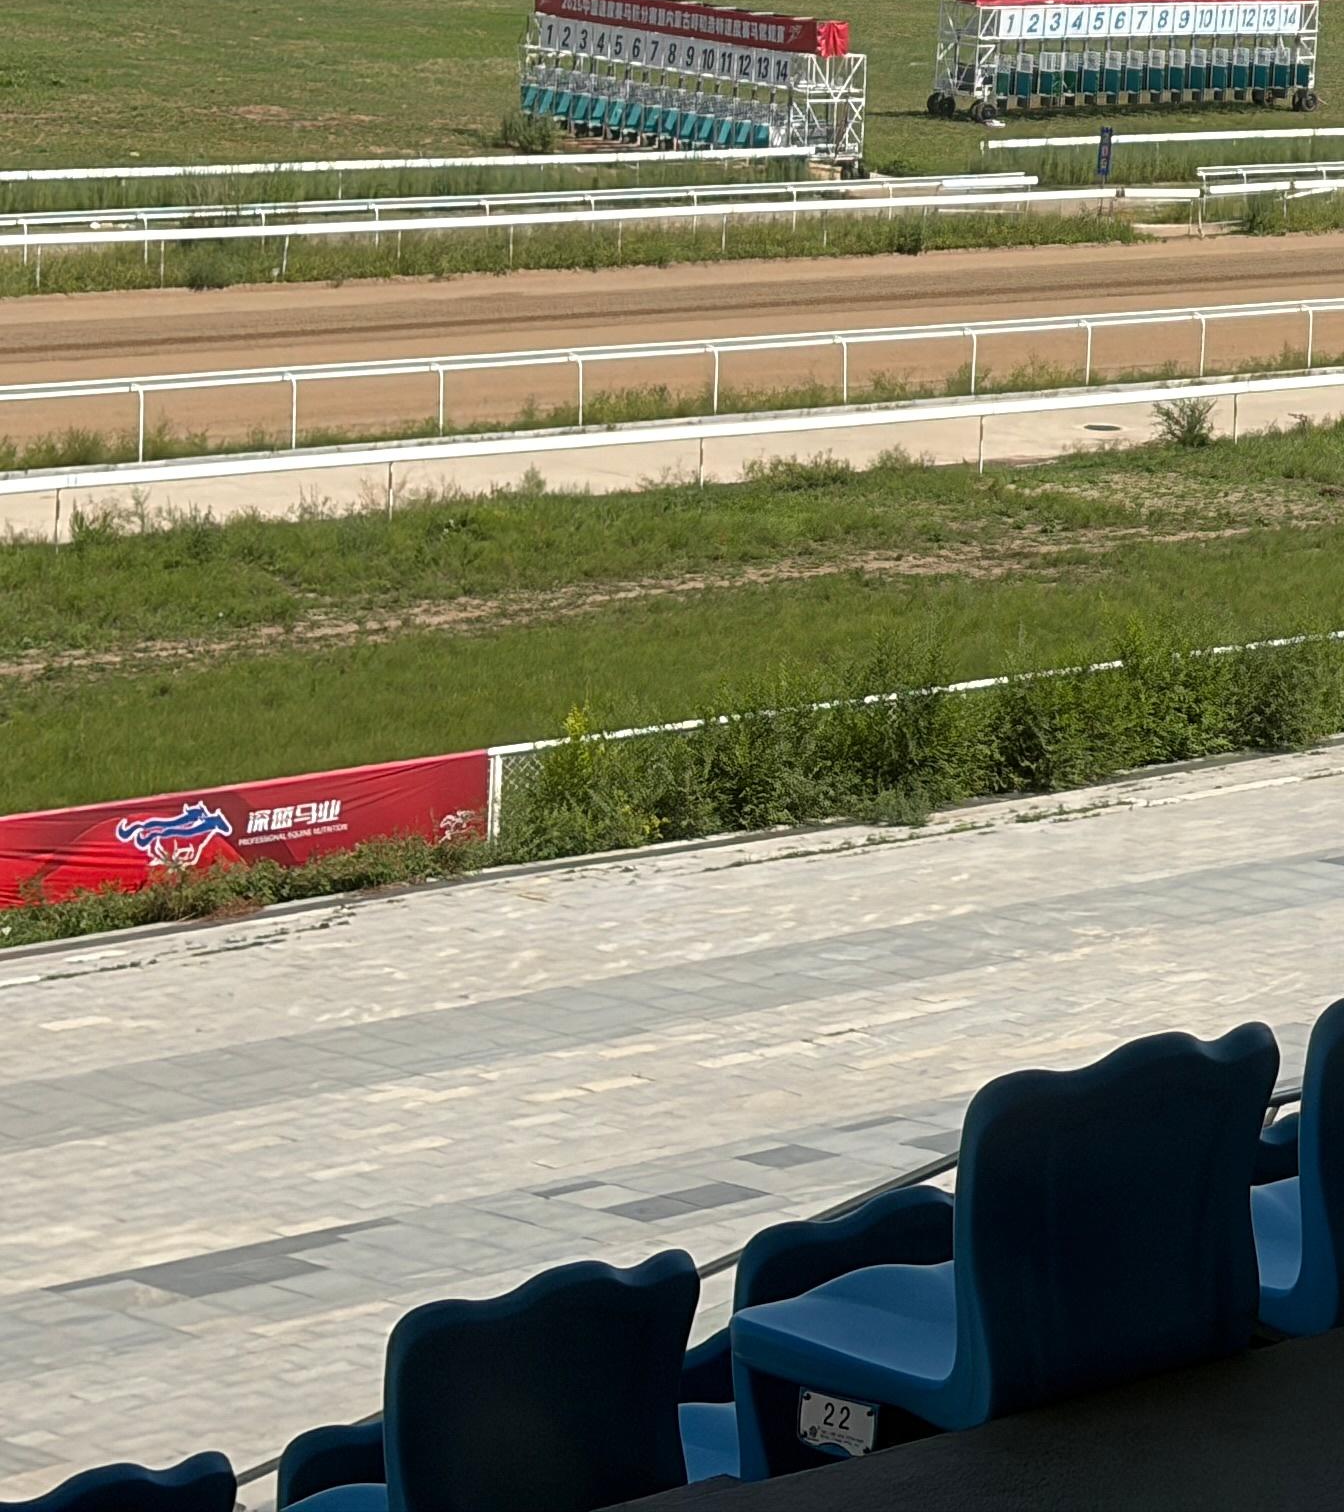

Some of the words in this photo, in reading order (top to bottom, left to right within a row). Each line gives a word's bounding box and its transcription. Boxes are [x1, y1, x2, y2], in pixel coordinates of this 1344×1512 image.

[1007, 13, 1015, 33] 1
[1027, 13, 1039, 33] 2
[1050, 12, 1061, 31] 3
[1072, 11, 1083, 30] 4
[1093, 11, 1105, 30] 5
[1114, 10, 1126, 29] 6
[1136, 10, 1147, 29] 7
[1157, 9, 1169, 28] 8
[1179, 9, 1190, 29] 9
[1199, 9, 1213, 28] 10
[1221, 8, 1234, 28] 11
[1242, 8, 1255, 27] 12
[1262, 8, 1276, 27] 13
[1283, 7, 1297, 25] 14
[547, 24, 553, 45] 1
[562, 26, 571, 47] 2
[580, 29, 588, 49] 3
[597, 32, 605, 53] 4
[614, 35, 623, 55] 5
[632, 37, 641, 58] 6
[651, 40, 659, 61] 7
[669, 43, 677, 64] 8
[686, 46, 694, 66] 9
[703, 48, 714, 70] 10
[722, 51, 732, 73] 11
[739, 54, 751, 76] 12
[758, 57, 769, 79] 13
[776, 59, 788, 82] 14
[246, 799, 341, 834] 深蓝马业
[823, 1402, 850, 1430] 22
